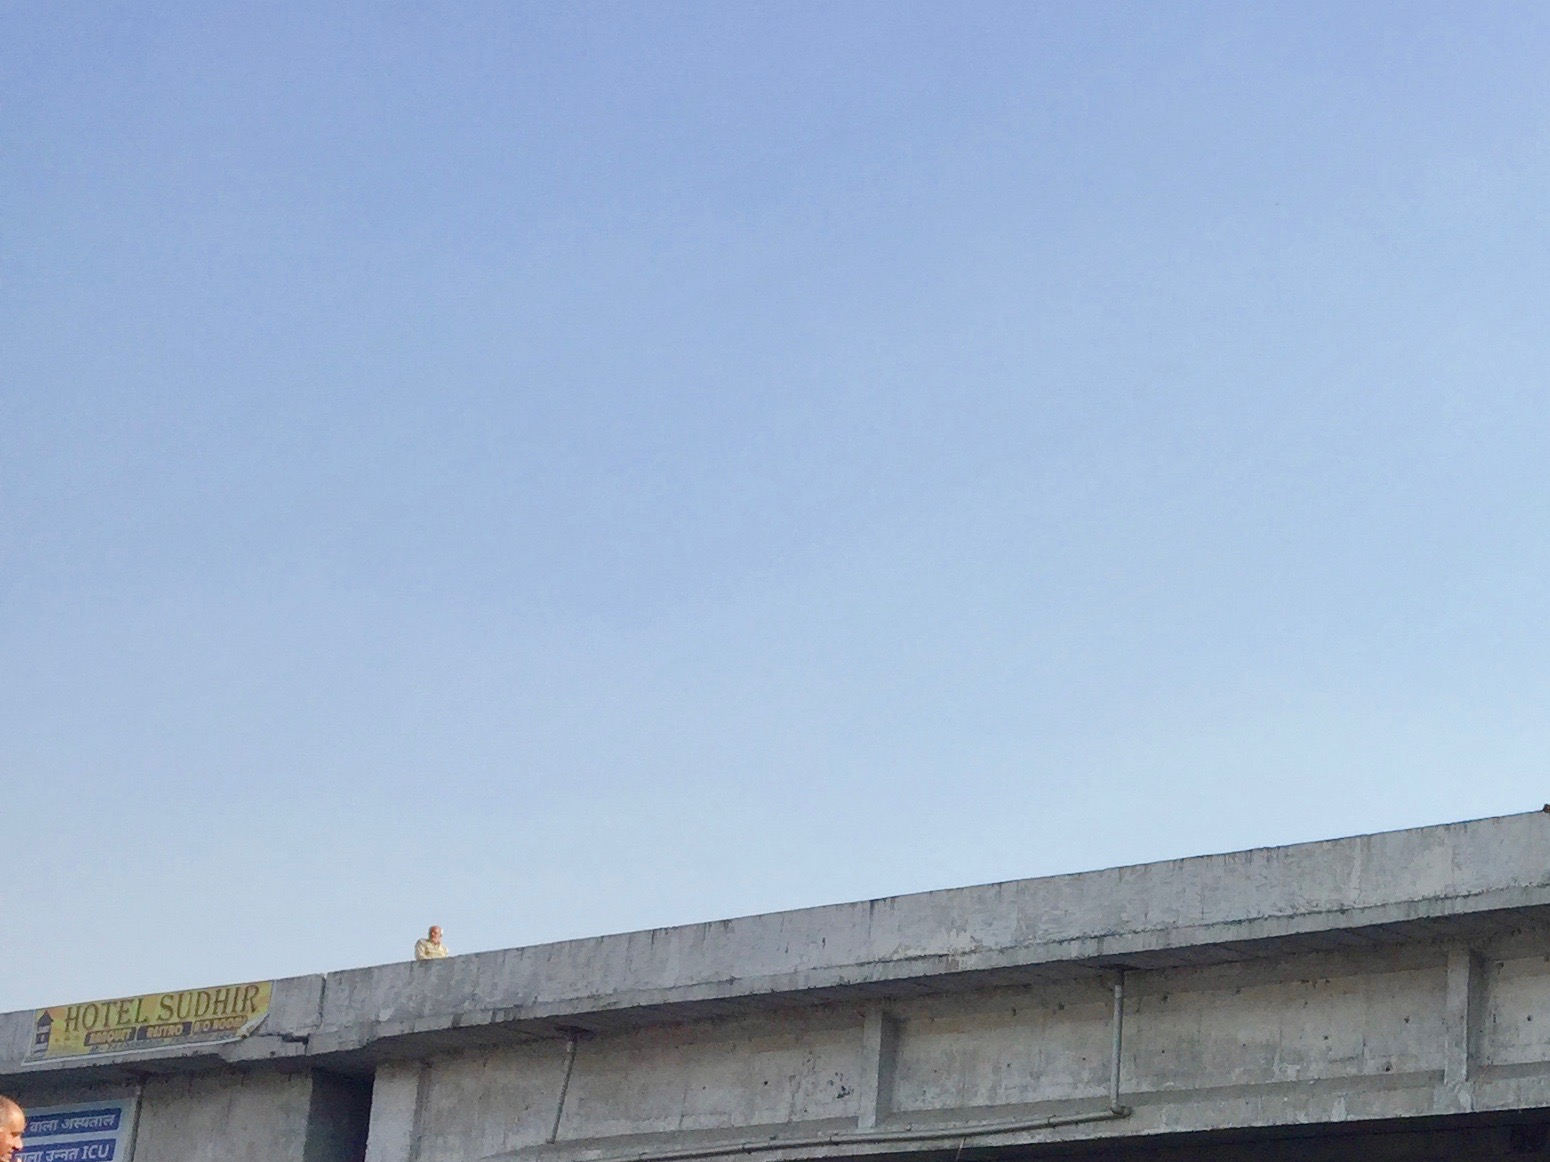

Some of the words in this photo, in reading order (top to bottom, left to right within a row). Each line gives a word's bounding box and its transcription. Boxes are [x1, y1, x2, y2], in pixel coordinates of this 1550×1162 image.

[64, 998, 148, 1033] HOTEL
[156, 984, 260, 1021] SUDHIR
[29, 1118, 58, 1133] वाला
[61, 1114, 116, 1130] अस्पताल
[45, 1147, 79, 1162] उन्नत
[81, 1144, 110, 1160] ICU
